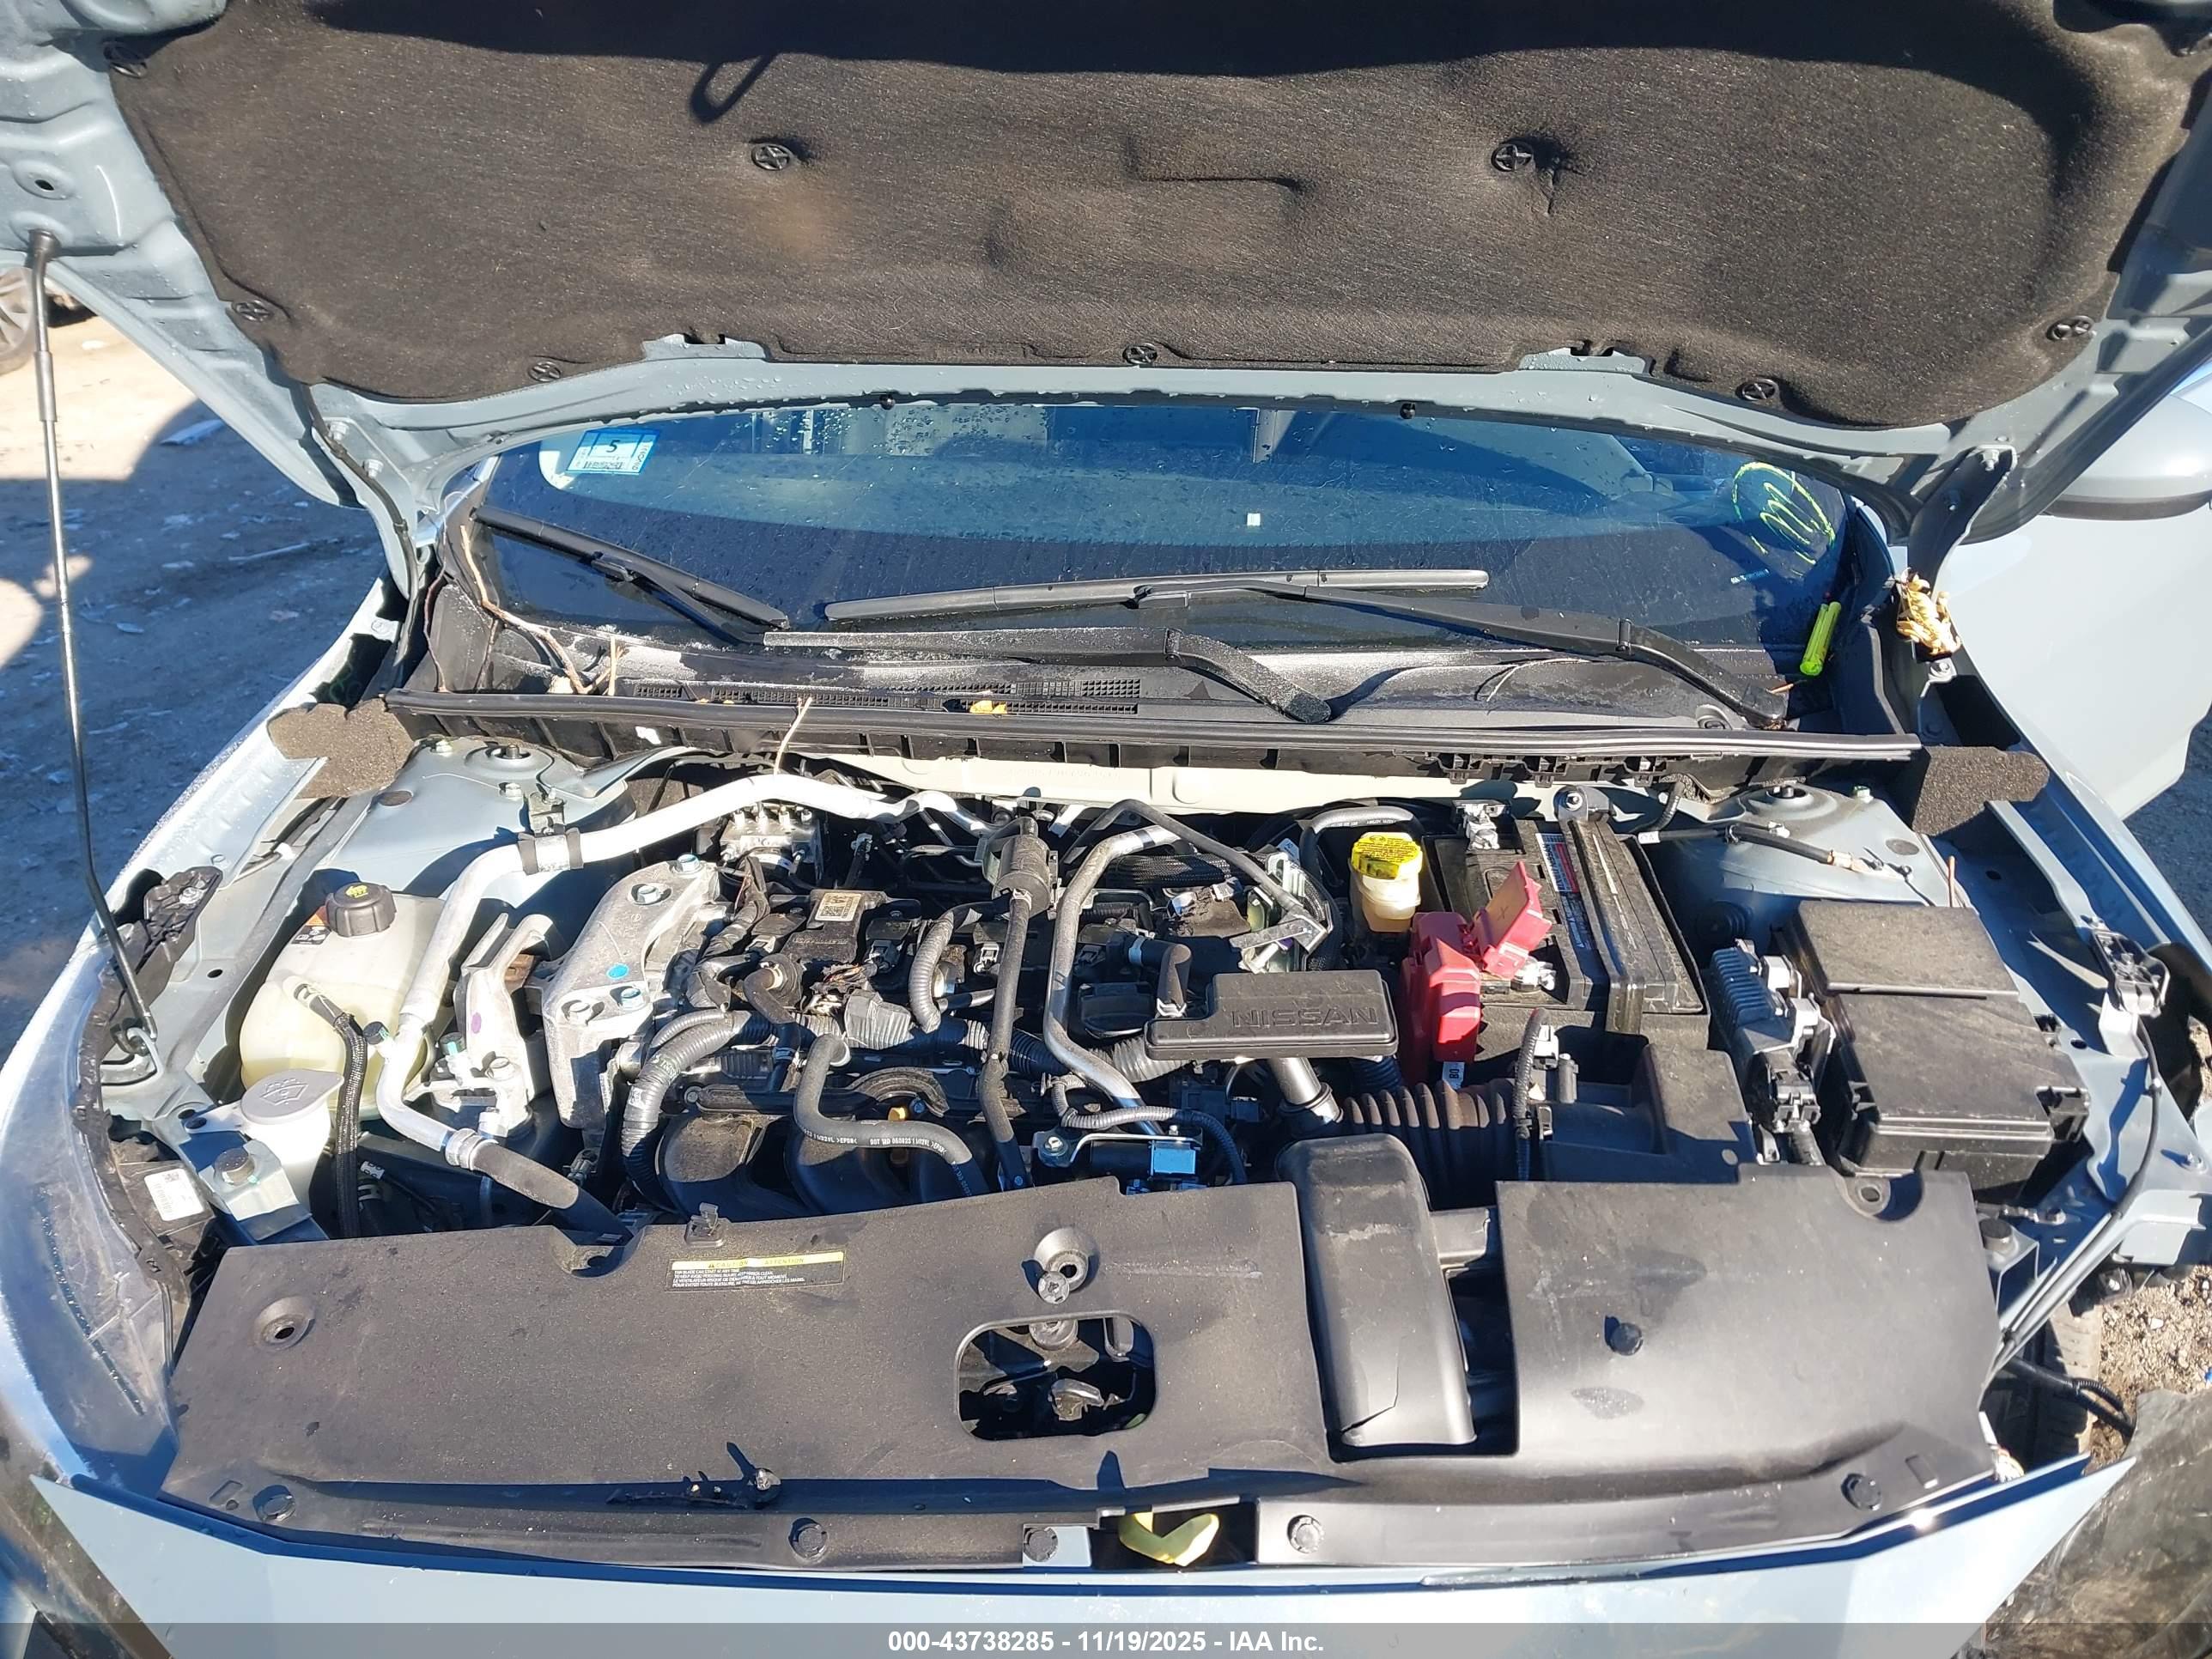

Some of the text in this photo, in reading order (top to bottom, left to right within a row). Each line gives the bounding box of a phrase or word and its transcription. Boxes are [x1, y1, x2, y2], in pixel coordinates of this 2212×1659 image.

[605, 439, 620, 453] 5
[1231, 1007, 1378, 1028] NISSAN
[716, 1260, 748, 1268] CAUTION
